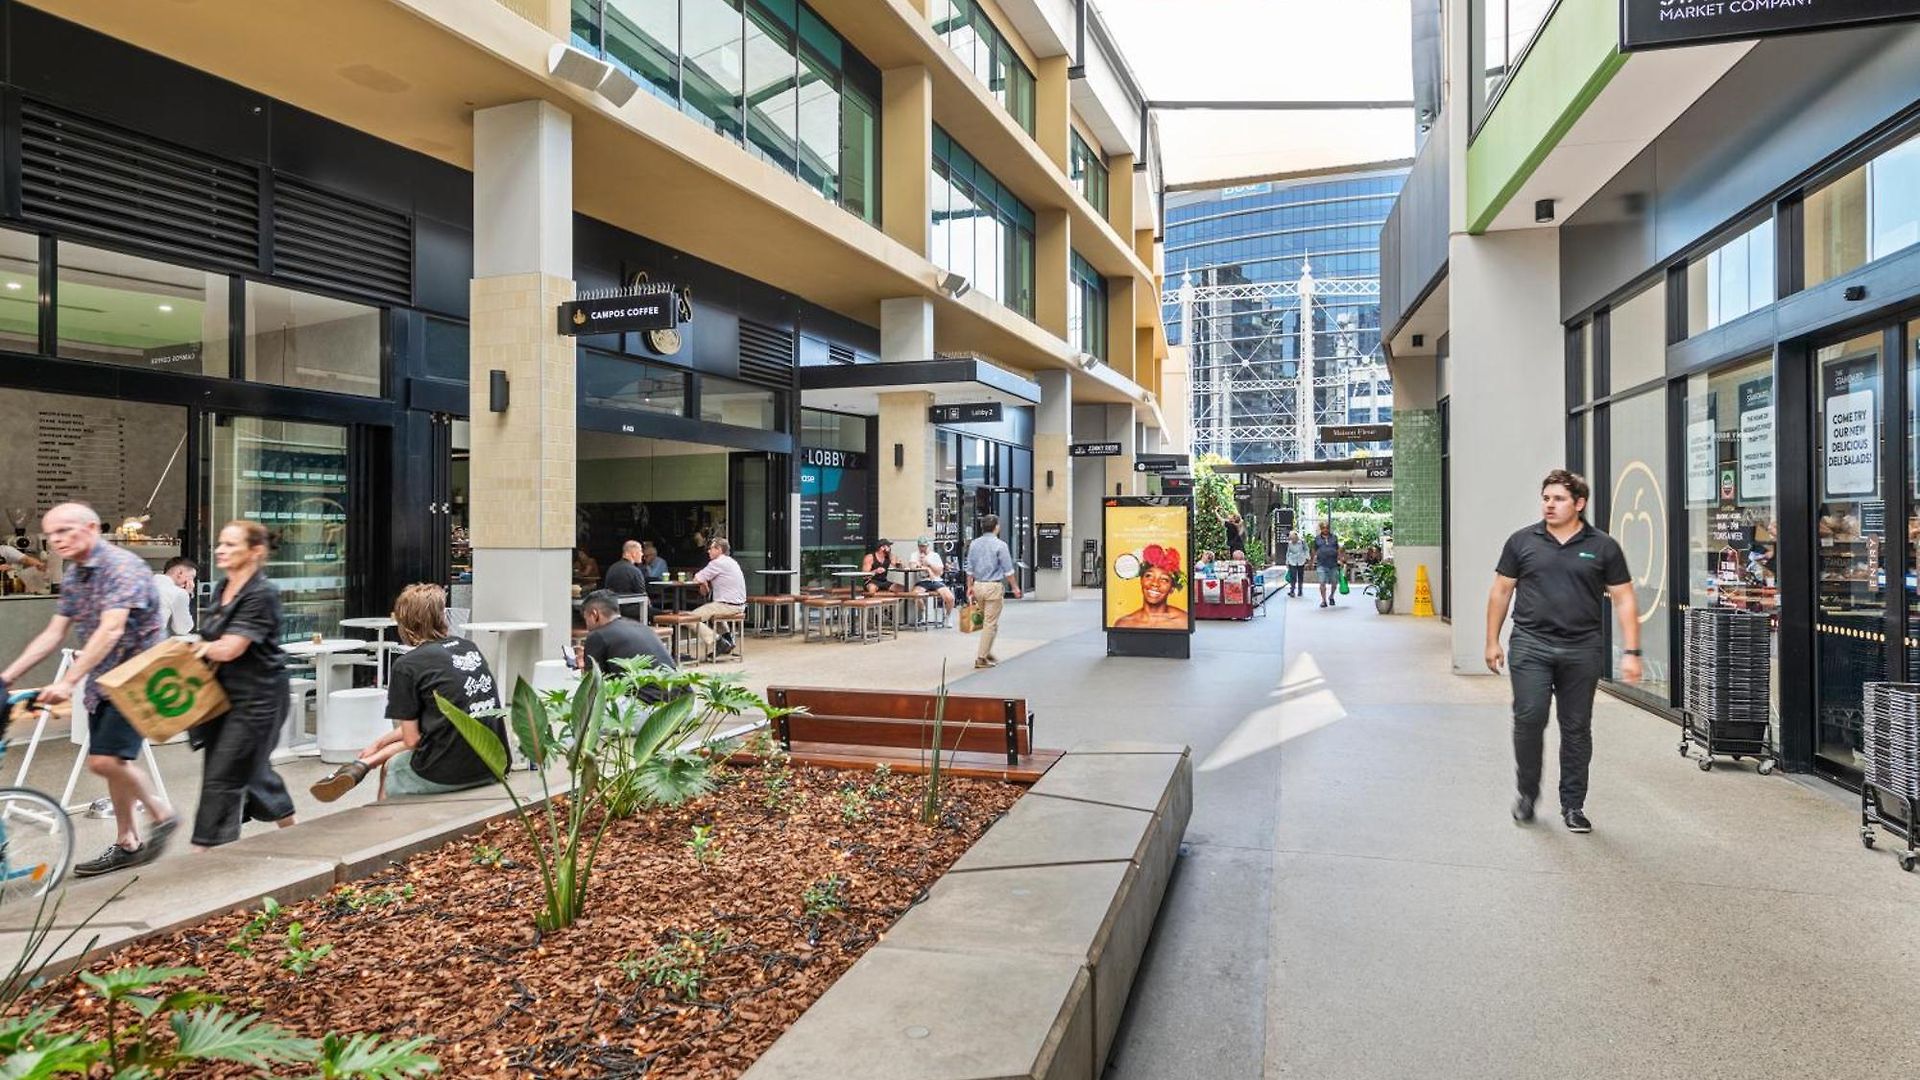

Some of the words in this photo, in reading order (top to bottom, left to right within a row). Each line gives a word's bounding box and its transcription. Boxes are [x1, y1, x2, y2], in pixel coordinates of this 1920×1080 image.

[1659, 3, 1724, 21] MARKET
[591, 309, 625, 320] CAMPOS
[627, 306, 659, 316] COFFEE
[1832, 411, 1853, 424] COME
[1854, 409, 1867, 421] TRY
[1833, 427, 1849, 438] OUR
[1850, 425, 1866, 436] NEW
[1832, 439, 1868, 452] DELICIOUS
[808, 449, 846, 467] LOBBY
[1828, 456, 1843, 467] DELI
[1869, 538, 1877, 587] ENTRY
